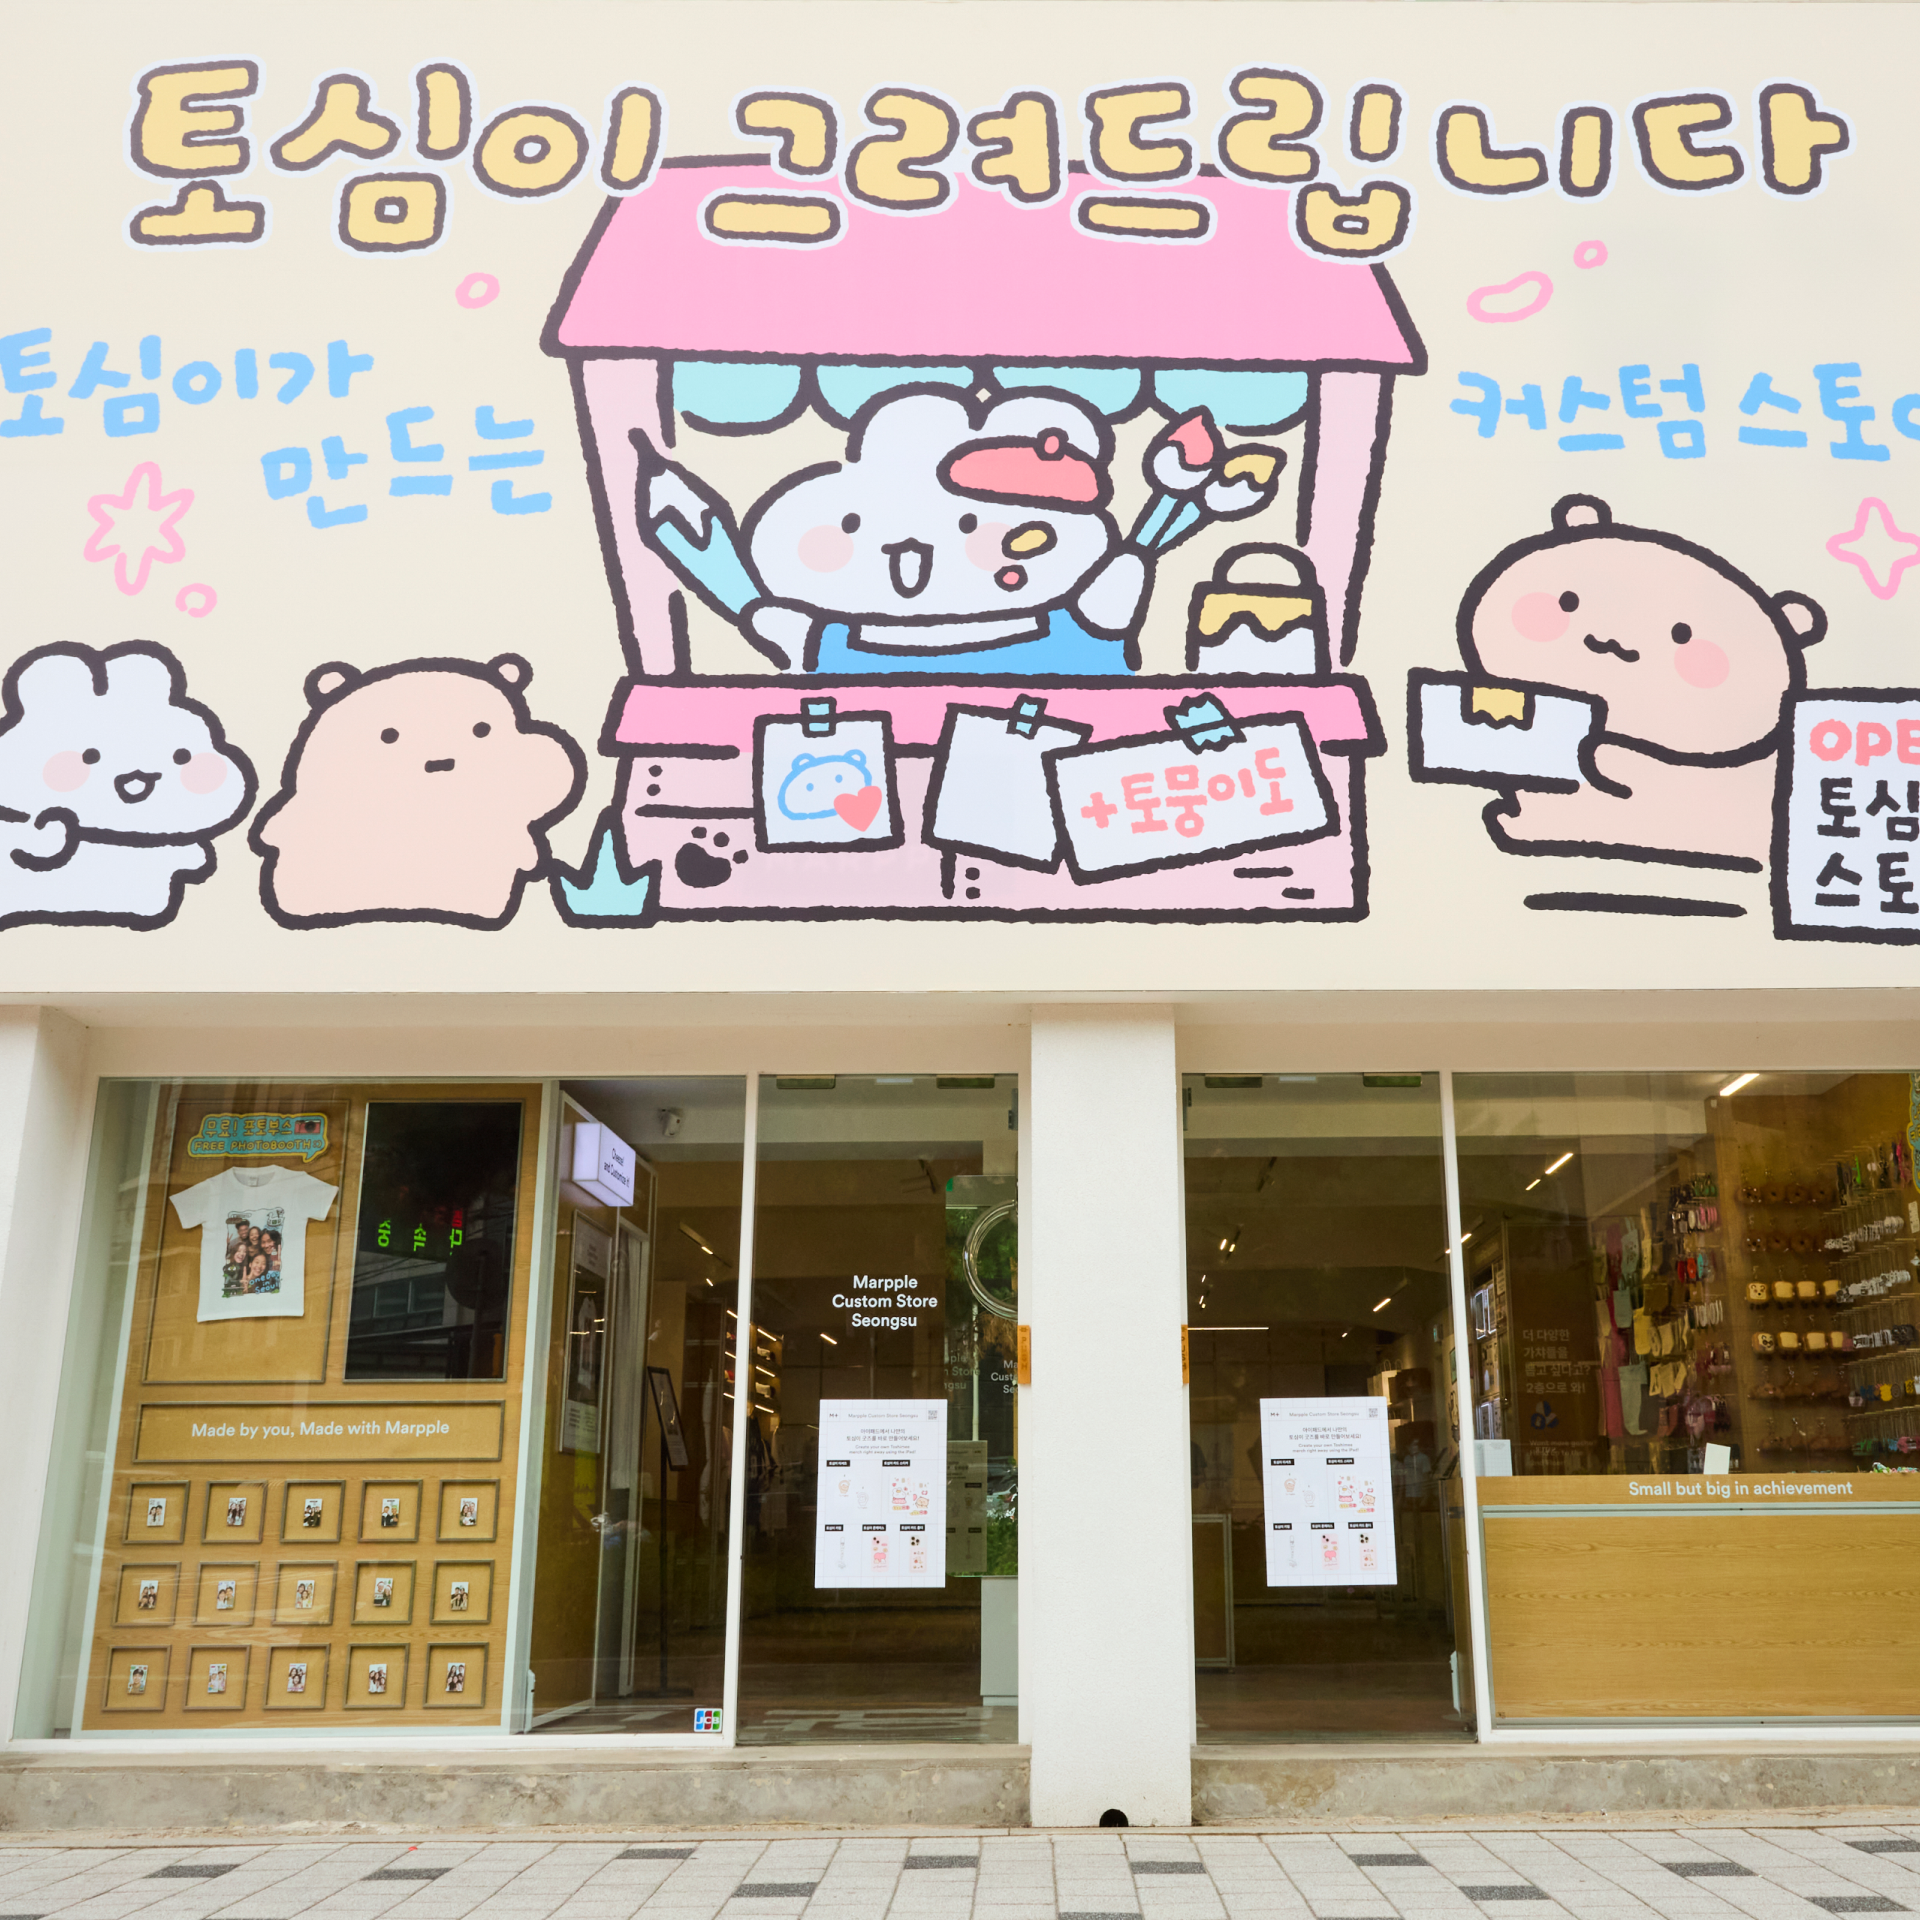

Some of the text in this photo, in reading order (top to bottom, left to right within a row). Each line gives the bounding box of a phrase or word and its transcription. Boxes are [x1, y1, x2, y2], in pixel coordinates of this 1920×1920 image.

[130, 60, 1849, 257] 토심이 그려드립니다
[0, 327, 374, 437] 토심이가
[1450, 363, 1706, 460] 커스텀
[260, 406, 552, 529] 만드는
[205, 1118, 292, 1138] 무료! 포토부스
[193, 1140, 226, 1151] FREE
[255, 1282, 278, 1295] Seoul
[853, 1275, 918, 1291] Marpple
[832, 1294, 938, 1308] Custom Store
[851, 1313, 917, 1330] Seongsu
[1522, 1329, 1570, 1341] 더 다양한
[1526, 1382, 1586, 1394] 2층으로 와!
[192, 1420, 449, 1439] Made by you, Made with Marpple
[1629, 1481, 1853, 1498] Small but big in achievement
